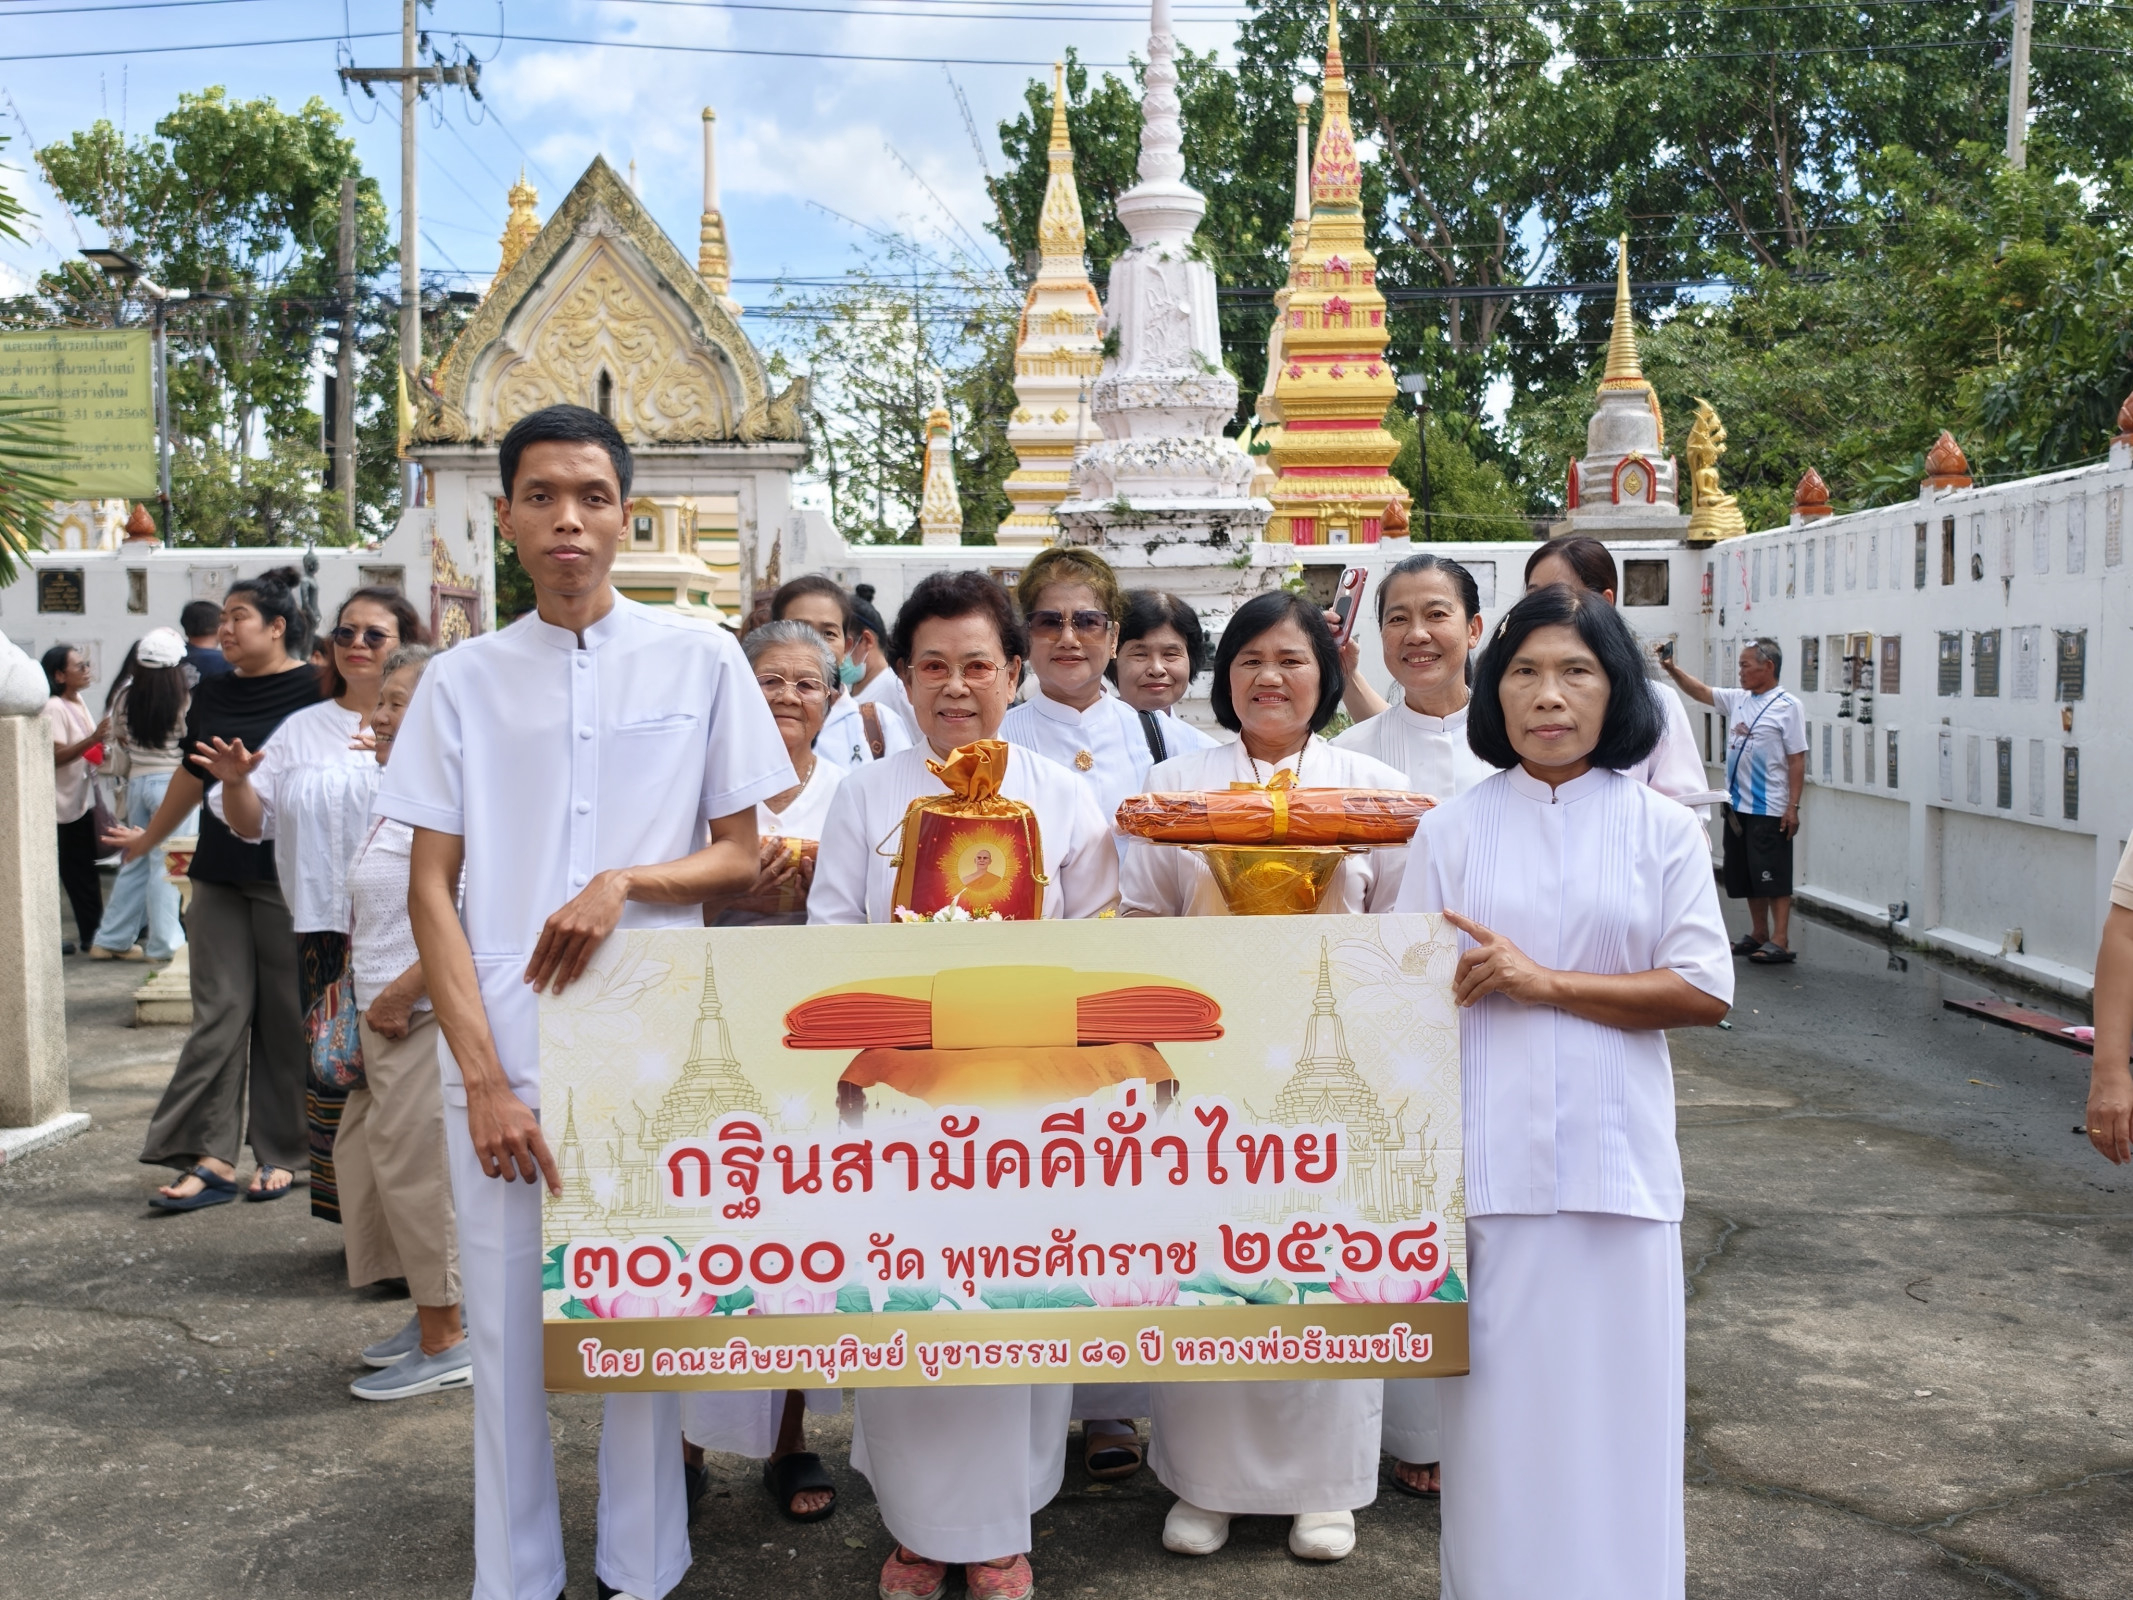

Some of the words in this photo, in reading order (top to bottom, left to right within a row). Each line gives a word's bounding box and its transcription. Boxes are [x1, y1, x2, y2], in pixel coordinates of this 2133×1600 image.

[667, 1087, 1338, 1220] กฐินสามัคคีทั่วไทย
[573, 1240, 846, 1297] ๓๐,๐๐๐
[867, 1232, 925, 1281] วัด
[941, 1228, 1198, 1297] พุทธศักราช
[1218, 1220, 1439, 1275] ๒๕๖๘
[582, 1342, 641, 1374] โดย
[656, 1332, 905, 1379] คณะศิษยานุศิษย์
[920, 1340, 1069, 1378] บูชาธรรม
[1082, 1343, 1127, 1364] ๘๑
[1140, 1331, 1162, 1363] ปี
[1176, 1326, 1430, 1363] หลวงพ่อธัมมชโย
